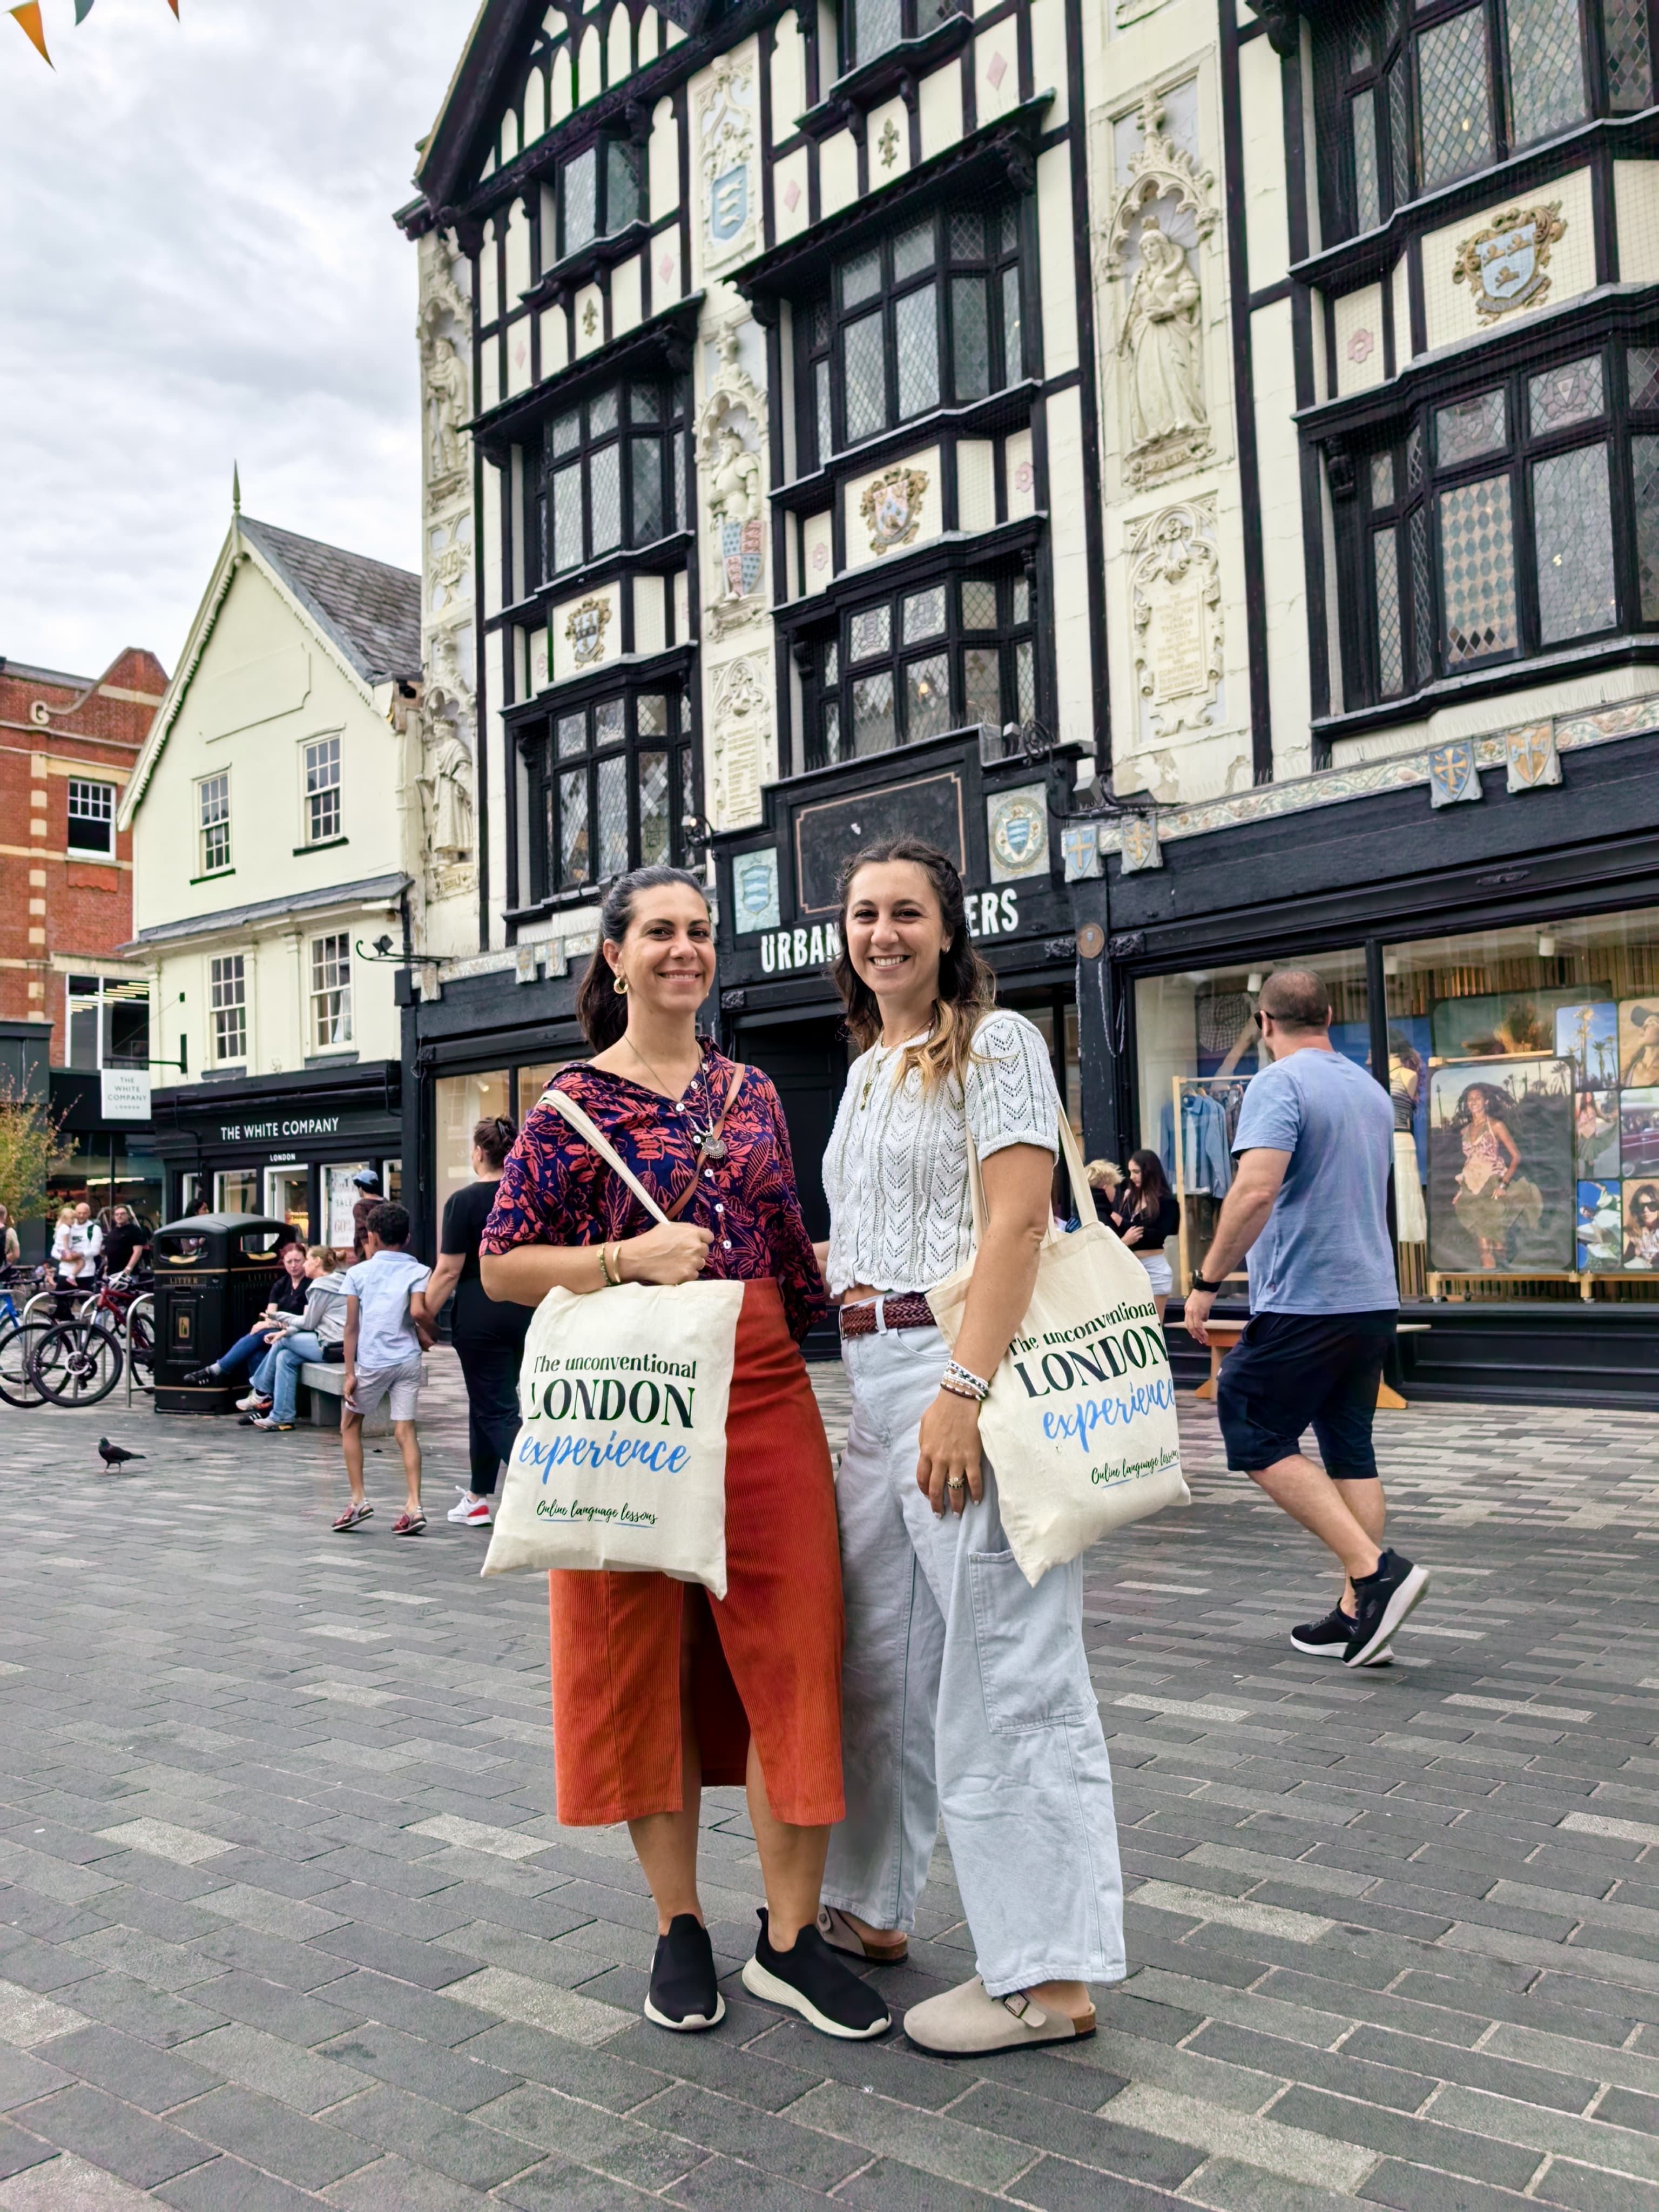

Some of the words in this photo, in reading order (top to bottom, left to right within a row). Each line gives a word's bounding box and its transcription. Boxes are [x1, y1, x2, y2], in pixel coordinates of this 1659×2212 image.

[761, 921, 841, 973] URBAN
[221, 1126, 240, 1141] THE
[244, 1122, 279, 1138] WHITE
[282, 1117, 339, 1135] COMPANY
[270, 1153, 295, 1162] LONDON
[336, 1199, 353, 1207] SALE
[1008, 1337, 1040, 1357] The
[1042, 1301, 1157, 1345] unconventiona
[534, 1355, 560, 1373] The
[565, 1353, 697, 1379] unconventional
[1014, 1323, 1169, 1398] LONDON
[1043, 1378, 1175, 1453] experience
[518, 1429, 691, 1485] experience
[1091, 1462, 1120, 1485] Online
[1122, 1458, 1158, 1479] language
[537, 1499, 568, 1516] Online
[570, 1500, 618, 1522] language
[620, 1502, 658, 1525] lessons
